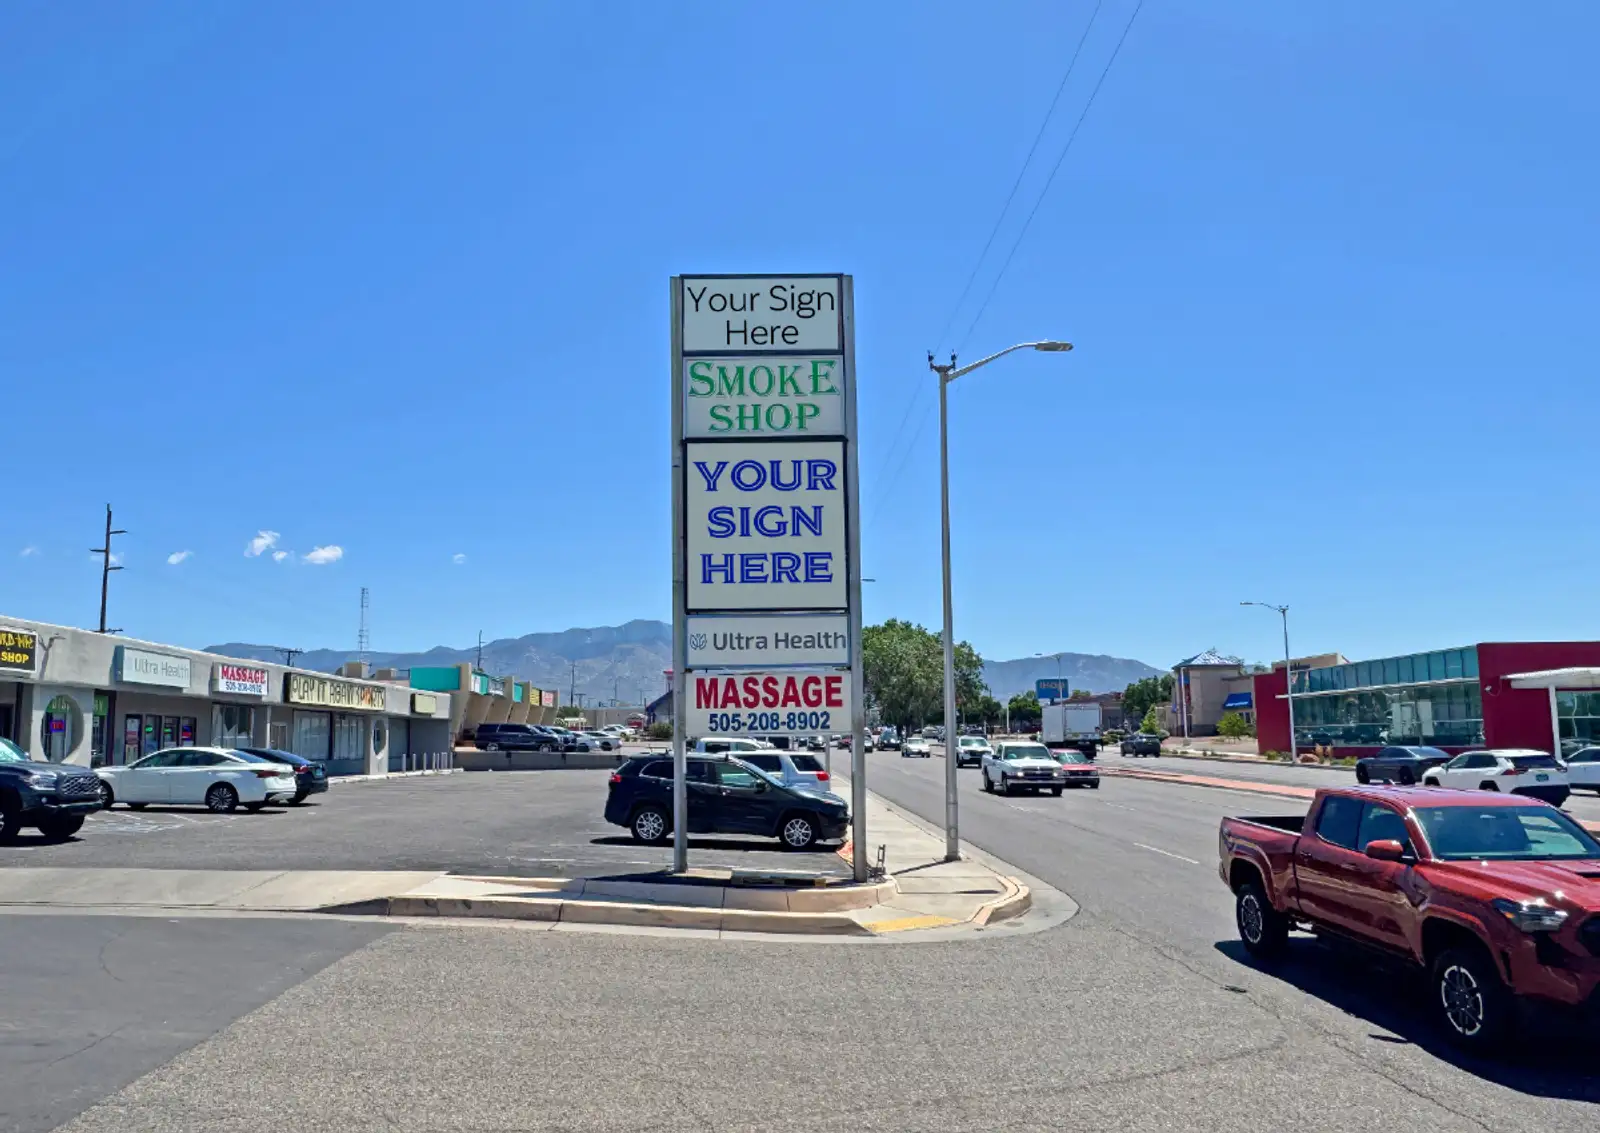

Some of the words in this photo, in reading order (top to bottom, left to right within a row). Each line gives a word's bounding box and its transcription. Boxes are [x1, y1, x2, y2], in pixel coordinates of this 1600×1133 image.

[687, 286, 760, 313] Your
[769, 285, 835, 319] Sign
[726, 320, 799, 345] Here
[688, 360, 840, 397] SMOKE
[709, 403, 820, 432] SHOP
[693, 459, 838, 492] YOUR
[707, 505, 825, 538] SIGN
[700, 551, 834, 584] HERE
[713, 633, 768, 650] Ultra
[774, 631, 847, 650] Health
[1, 651, 30, 664] SHOP
[134, 658, 158, 674] Ultra
[161, 662, 189, 680] Health
[221, 665, 266, 684] MASSAGE
[292, 676, 315, 700] PLAY
[317, 681, 327, 702] IT
[696, 676, 843, 709] MASSAGE
[708, 711, 831, 732] 505-208-8902
